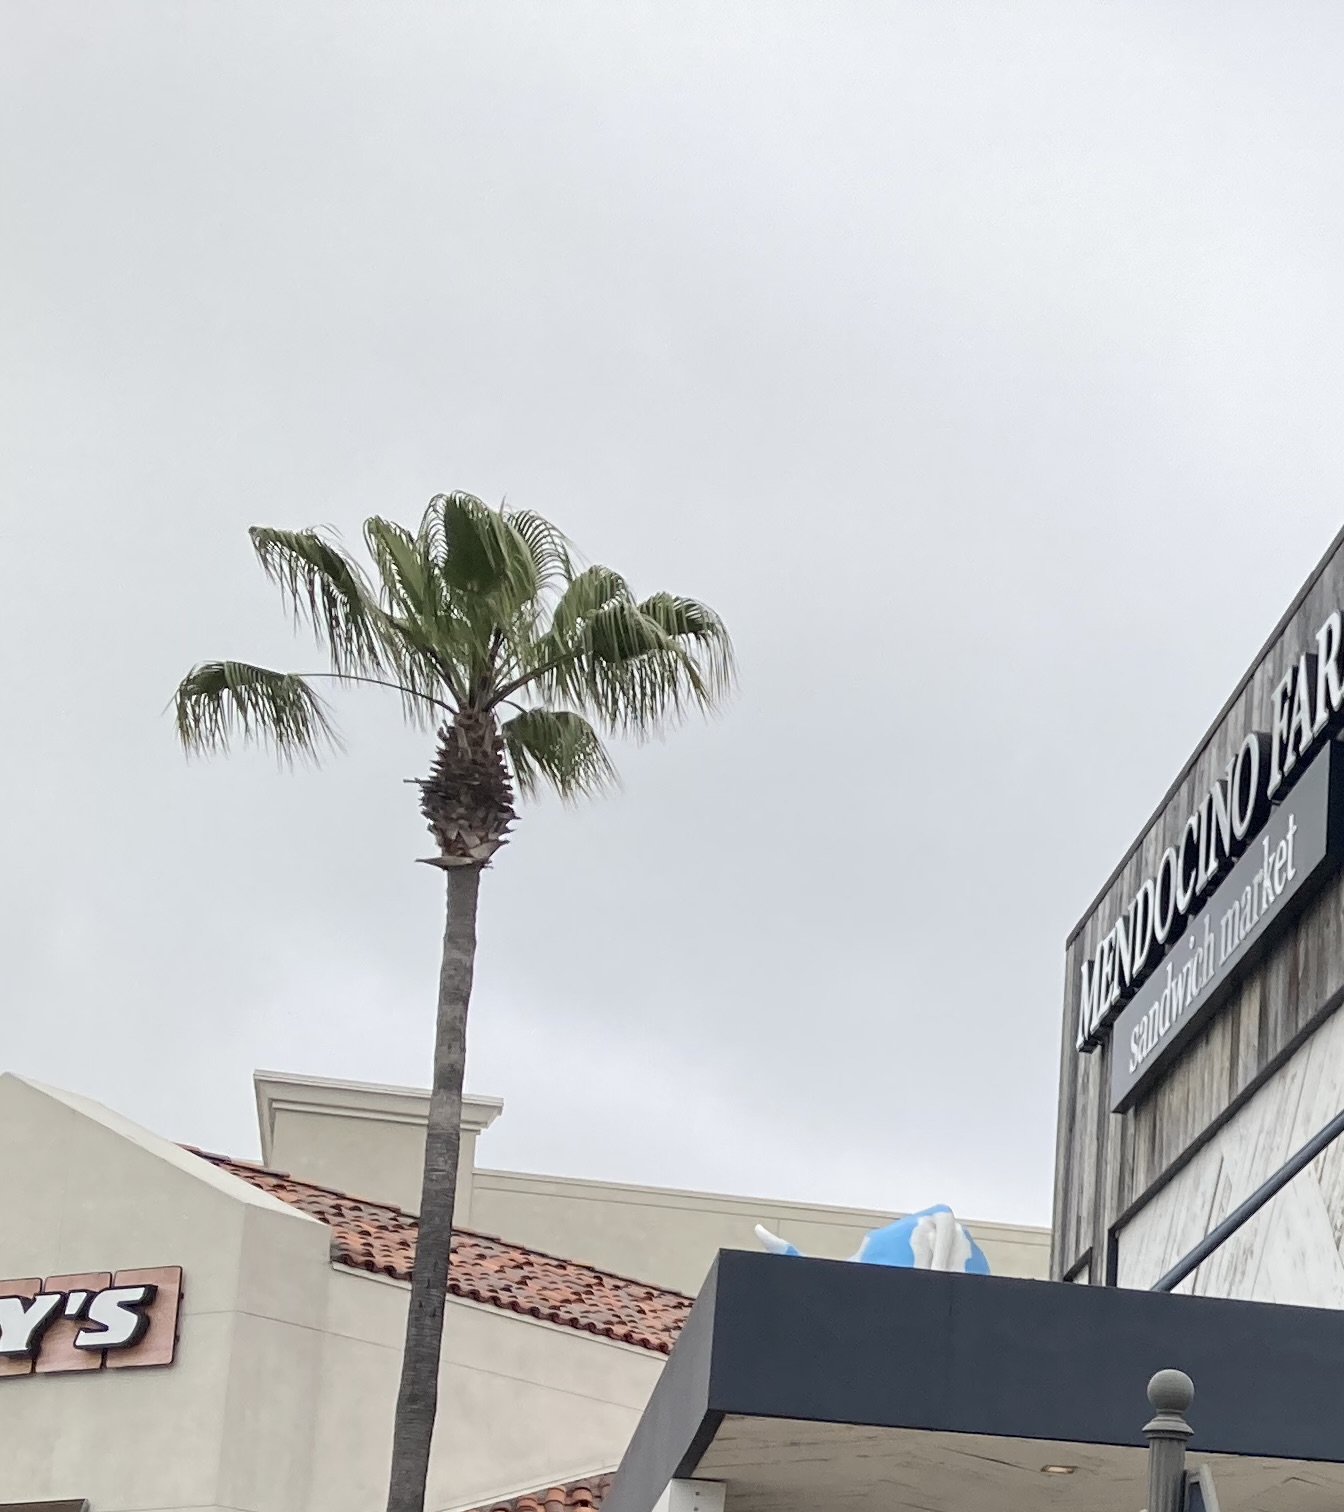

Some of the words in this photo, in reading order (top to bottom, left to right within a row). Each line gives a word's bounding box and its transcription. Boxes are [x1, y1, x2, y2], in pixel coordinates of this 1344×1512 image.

[1075, 729, 1262, 1052] MENDOCINO
[1128, 914, 1216, 1076] sandwich
[1218, 811, 1299, 967] market
